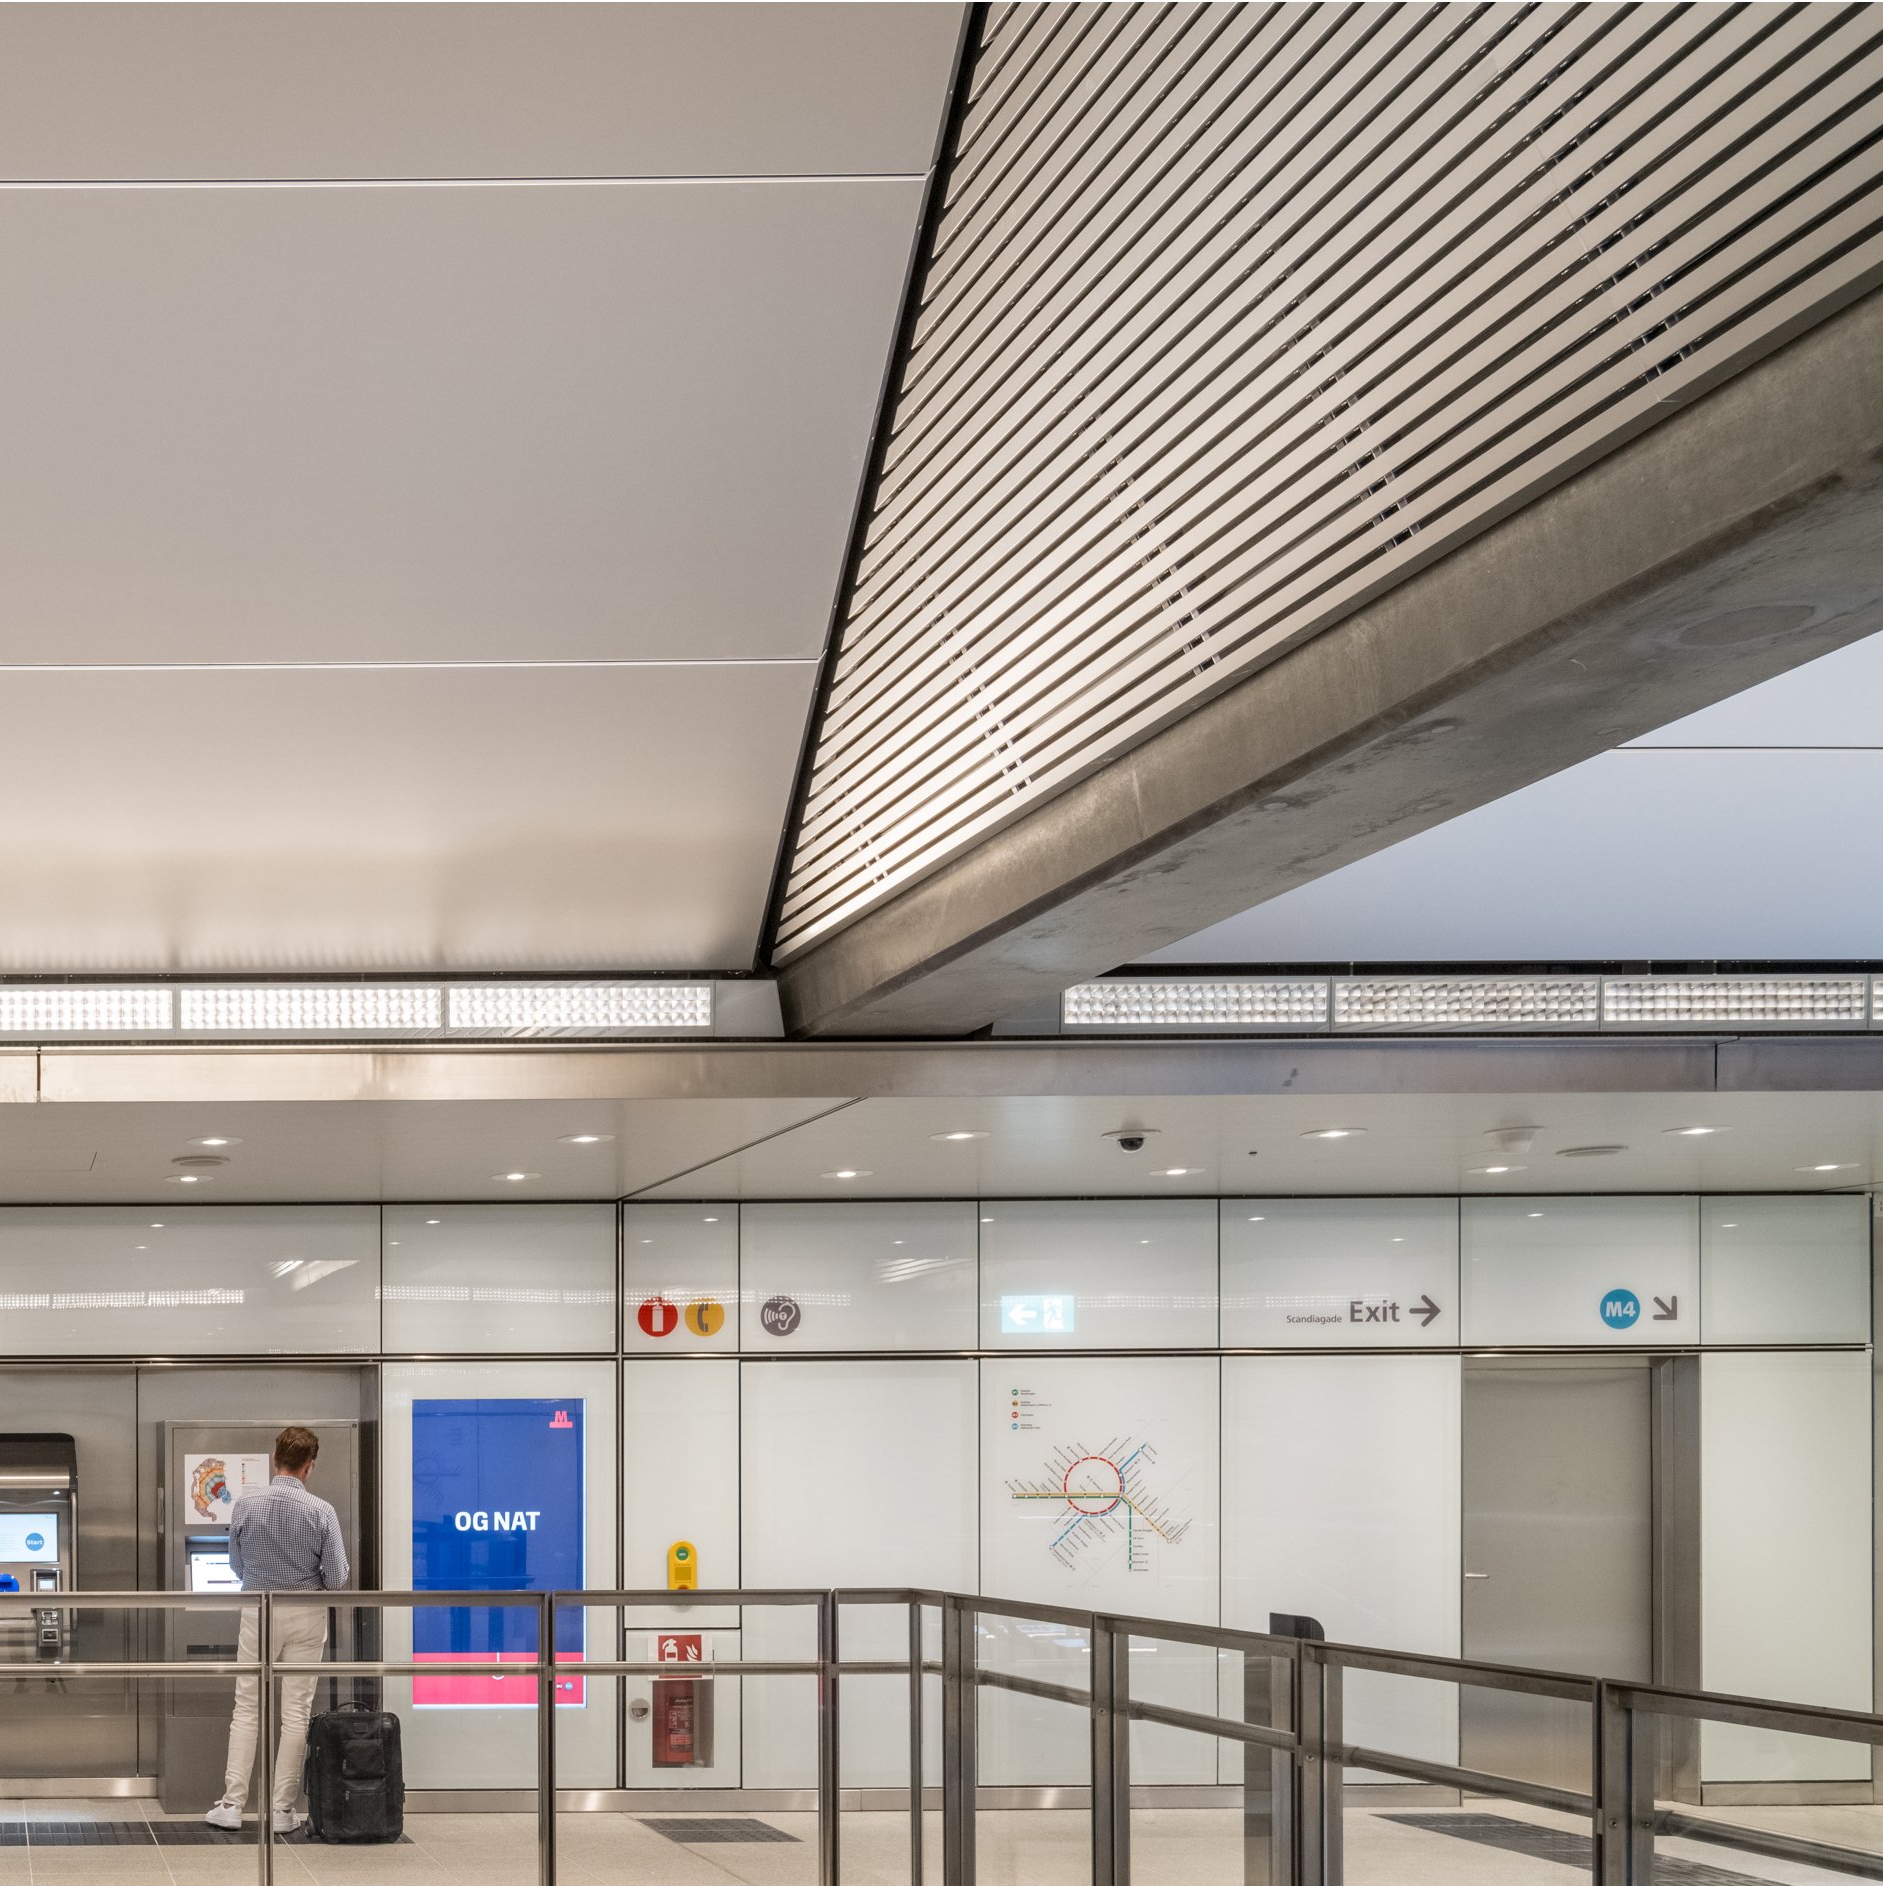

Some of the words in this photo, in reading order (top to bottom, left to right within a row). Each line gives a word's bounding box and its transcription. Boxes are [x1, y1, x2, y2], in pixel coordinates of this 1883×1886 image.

[1286, 1314, 1343, 1325] Scandiagade
[1350, 1300, 1400, 1322] Exit
[1605, 1301, 1636, 1317] M4
[454, 1511, 489, 1531] OG
[493, 1511, 541, 1531] NAT
